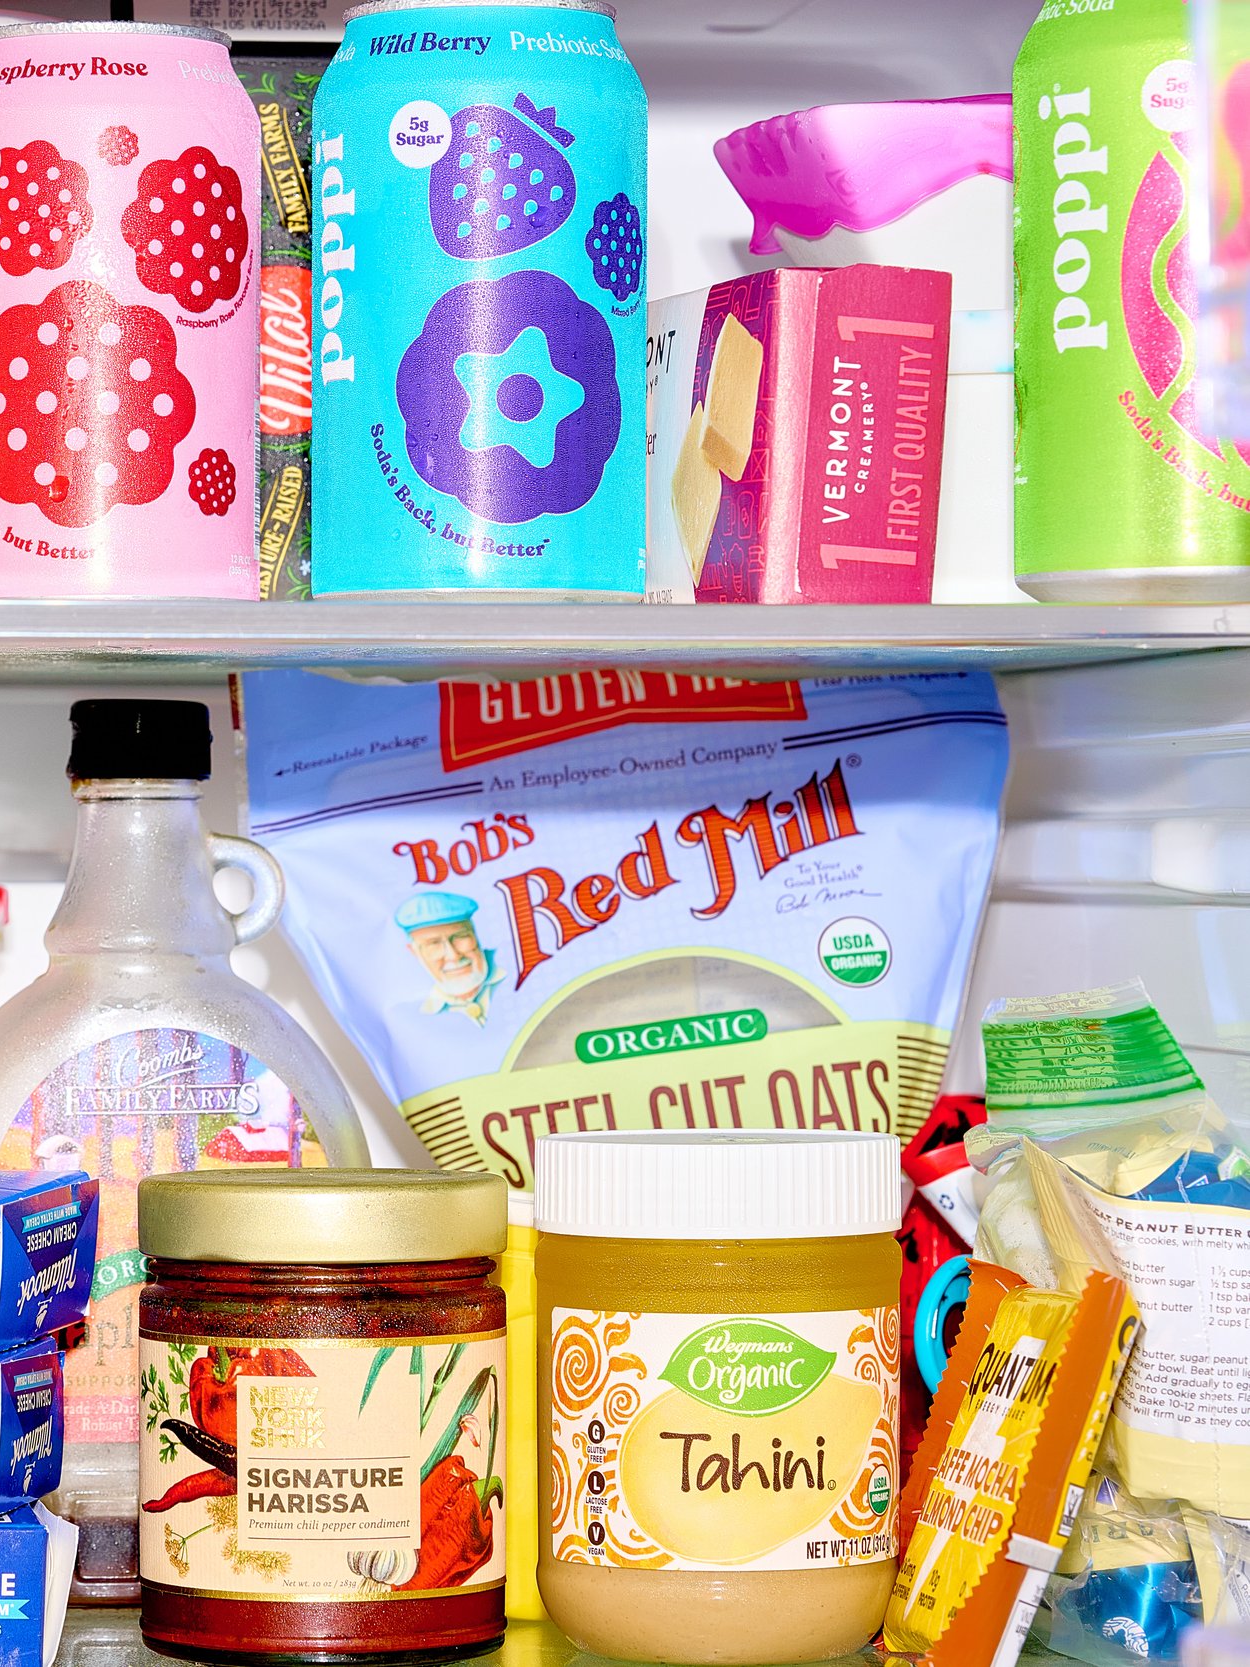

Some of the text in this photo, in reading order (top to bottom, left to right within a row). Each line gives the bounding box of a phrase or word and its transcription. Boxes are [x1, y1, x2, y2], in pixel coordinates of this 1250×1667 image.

[369, 32, 491, 56] Wild Berry
[509, 30, 602, 58] Prebiotic
[91, 57, 148, 77] Rose
[409, 116, 429, 133] 5g
[396, 132, 444, 148] Sugar
[259, 103, 308, 233] FAMILY FARMS
[1038, 83, 1108, 354] poppi
[316, 129, 355, 387] poppi
[822, 356, 862, 524] VERMONT
[886, 344, 933, 541] FIRST QUALITY
[370, 423, 476, 548] Soda's Back, but
[2, 527, 33, 553] but
[36, 540, 95, 559] Better
[370, 732, 429, 755] Package
[489, 740, 779, 793] An Employee-Owned Company
[392, 812, 535, 886] Bob's
[495, 757, 865, 992] Red Mill
[833, 934, 874, 951] USDA
[830, 953, 883, 971] ORGANIC
[586, 1013, 758, 1059] ORGANIC
[115, 1034, 205, 1088] Coombs
[65, 1082, 261, 1118] FAMILY FARMS
[1116, 1218, 1179, 1234] PEANUT
[1138, 1236, 1179, 1247] cookies,
[1133, 1263, 1165, 1272] butter
[1135, 1276, 1196, 1288] brown sugar
[1162, 1302, 1193, 1312] butter
[1218, 1319, 1242, 1328] cups
[701, 1330, 794, 1355] Wegmans
[1190, 1366, 1214, 1376] Beat
[1217, 1367, 1239, 1377] until
[1213, 1356, 1248, 1369] peanut
[688, 1355, 805, 1404] Organic
[968, 1342, 1058, 1410] QUANTUM
[1145, 1374, 1220, 1390] Add gradually
[249, 1386, 319, 1407] NEW
[1135, 1382, 1197, 1399] onto cookie
[1139, 1396, 1165, 1407] Bake
[1170, 1399, 1195, 1411] 10-12
[1153, 1409, 1174, 1419] firm
[250, 1407, 326, 1428] YORK
[250, 1427, 326, 1449] SHUK
[587, 1446, 606, 1454] GLUTEN
[590, 1455, 603, 1463] FREE
[659, 1431, 826, 1493] Tahini
[247, 1467, 403, 1489] SIGNATURE
[936, 1446, 1019, 1505] AFFE MOCHA
[247, 1493, 370, 1513] HARISSA
[586, 1497, 607, 1506] LACTOSE
[590, 1505, 603, 1514] FREE
[249, 1518, 410, 1533] Premium chili pepper condiment
[960, 1504, 1004, 1547] CHIP
[588, 1547, 605, 1555] VEGAN
[806, 1537, 871, 1559] NET WT 11 OZ
[282, 1579, 297, 1587] Net
